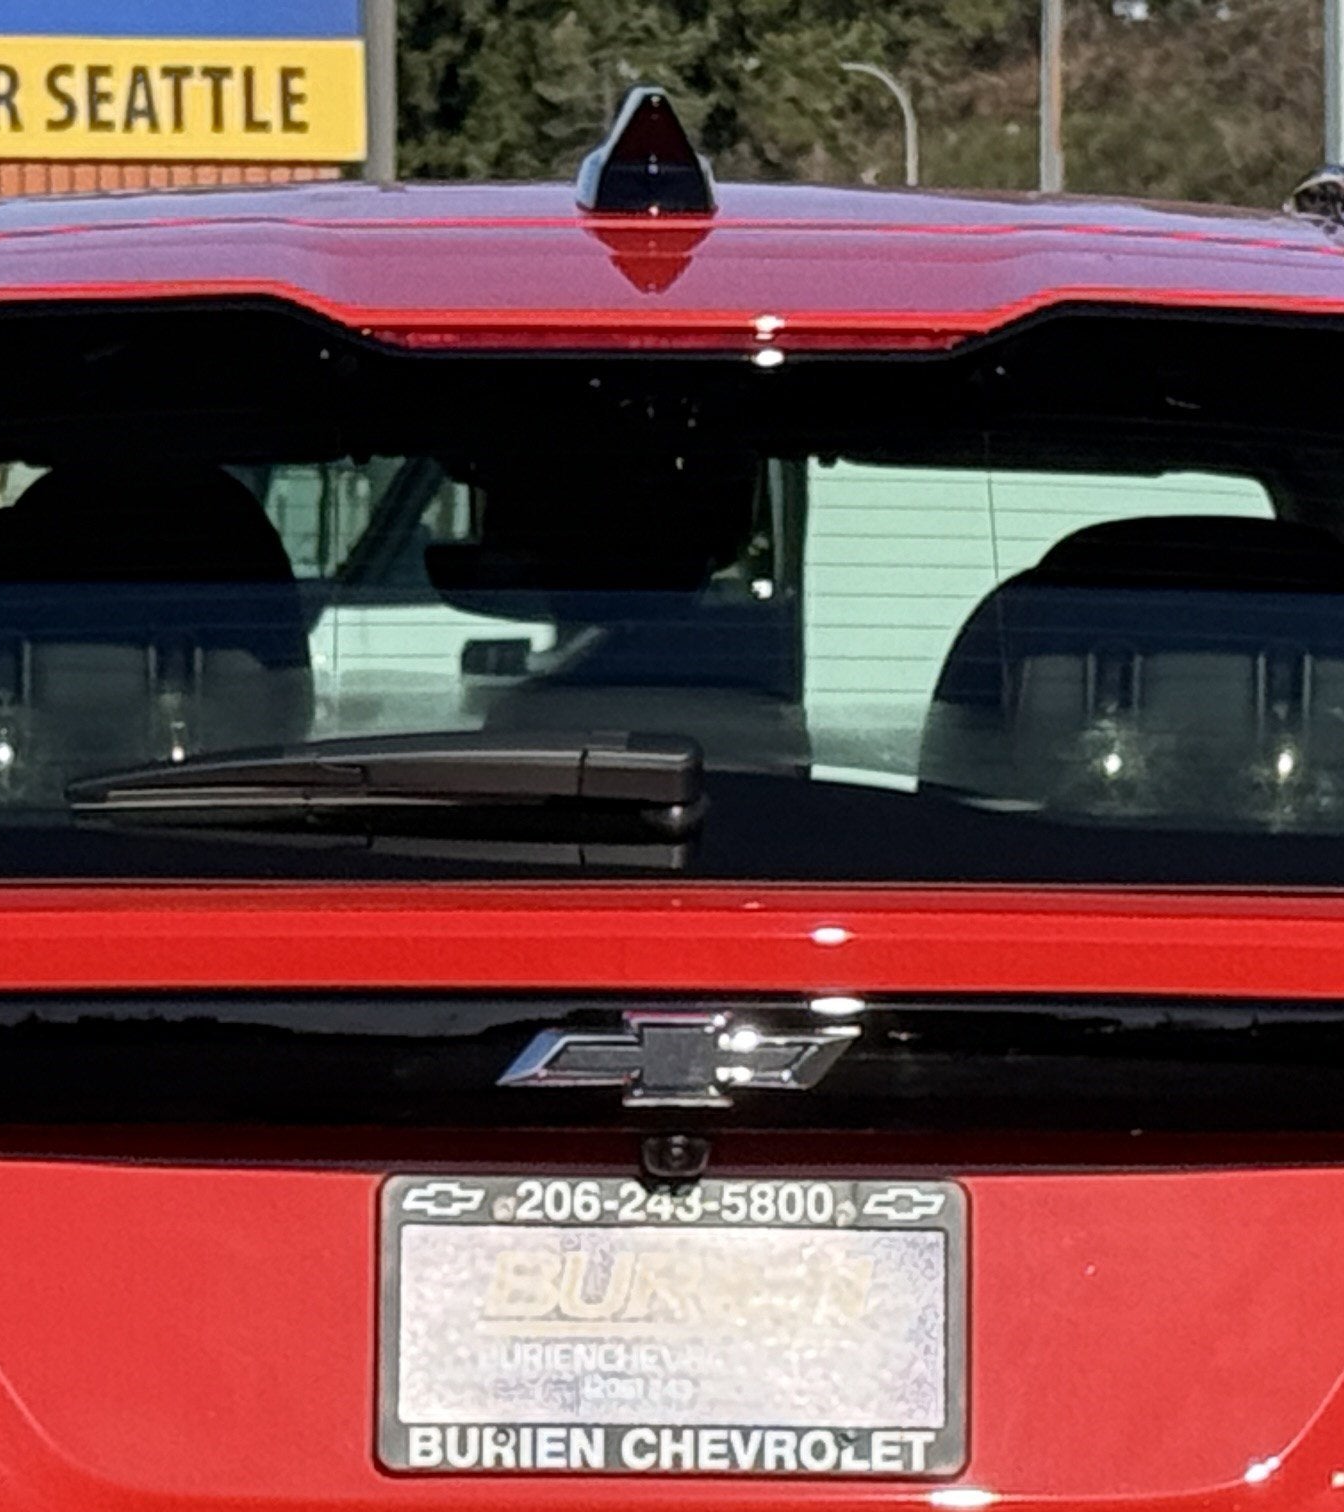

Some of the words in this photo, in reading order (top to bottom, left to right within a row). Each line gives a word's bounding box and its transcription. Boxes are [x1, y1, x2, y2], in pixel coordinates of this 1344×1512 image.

[45, 65, 309, 134] SEATTLE
[515, 1180, 835, 1223] 206-243-5800
[408, 1426, 605, 1468] BURIEN
[621, 1429, 936, 1472] CHEVROLET
